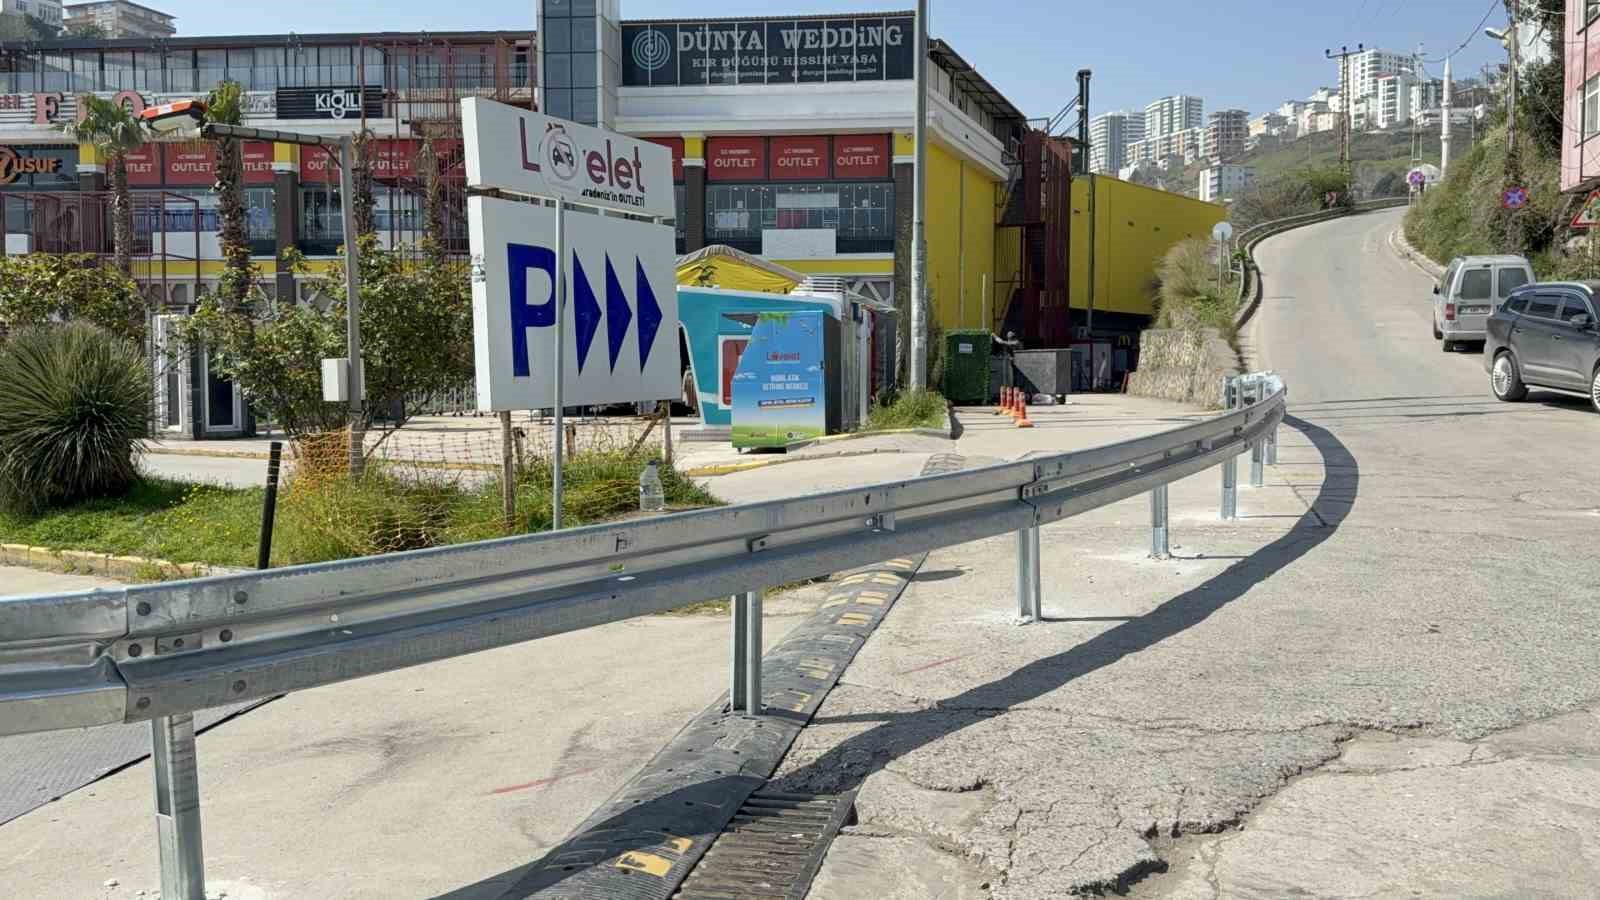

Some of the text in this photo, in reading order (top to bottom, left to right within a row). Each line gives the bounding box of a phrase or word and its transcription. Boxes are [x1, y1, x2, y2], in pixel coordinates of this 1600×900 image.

[679, 29, 763, 51] DÜNYA
[519, 116, 645, 192] Lelet
[714, 157, 757, 168] OUTLET
[777, 156, 821, 167] OUTLET
[836, 155, 880, 166] OUTLET
[124, 163, 153, 173] TLET
[171, 163, 212, 173] OUTLET
[507, 243, 566, 376] P
